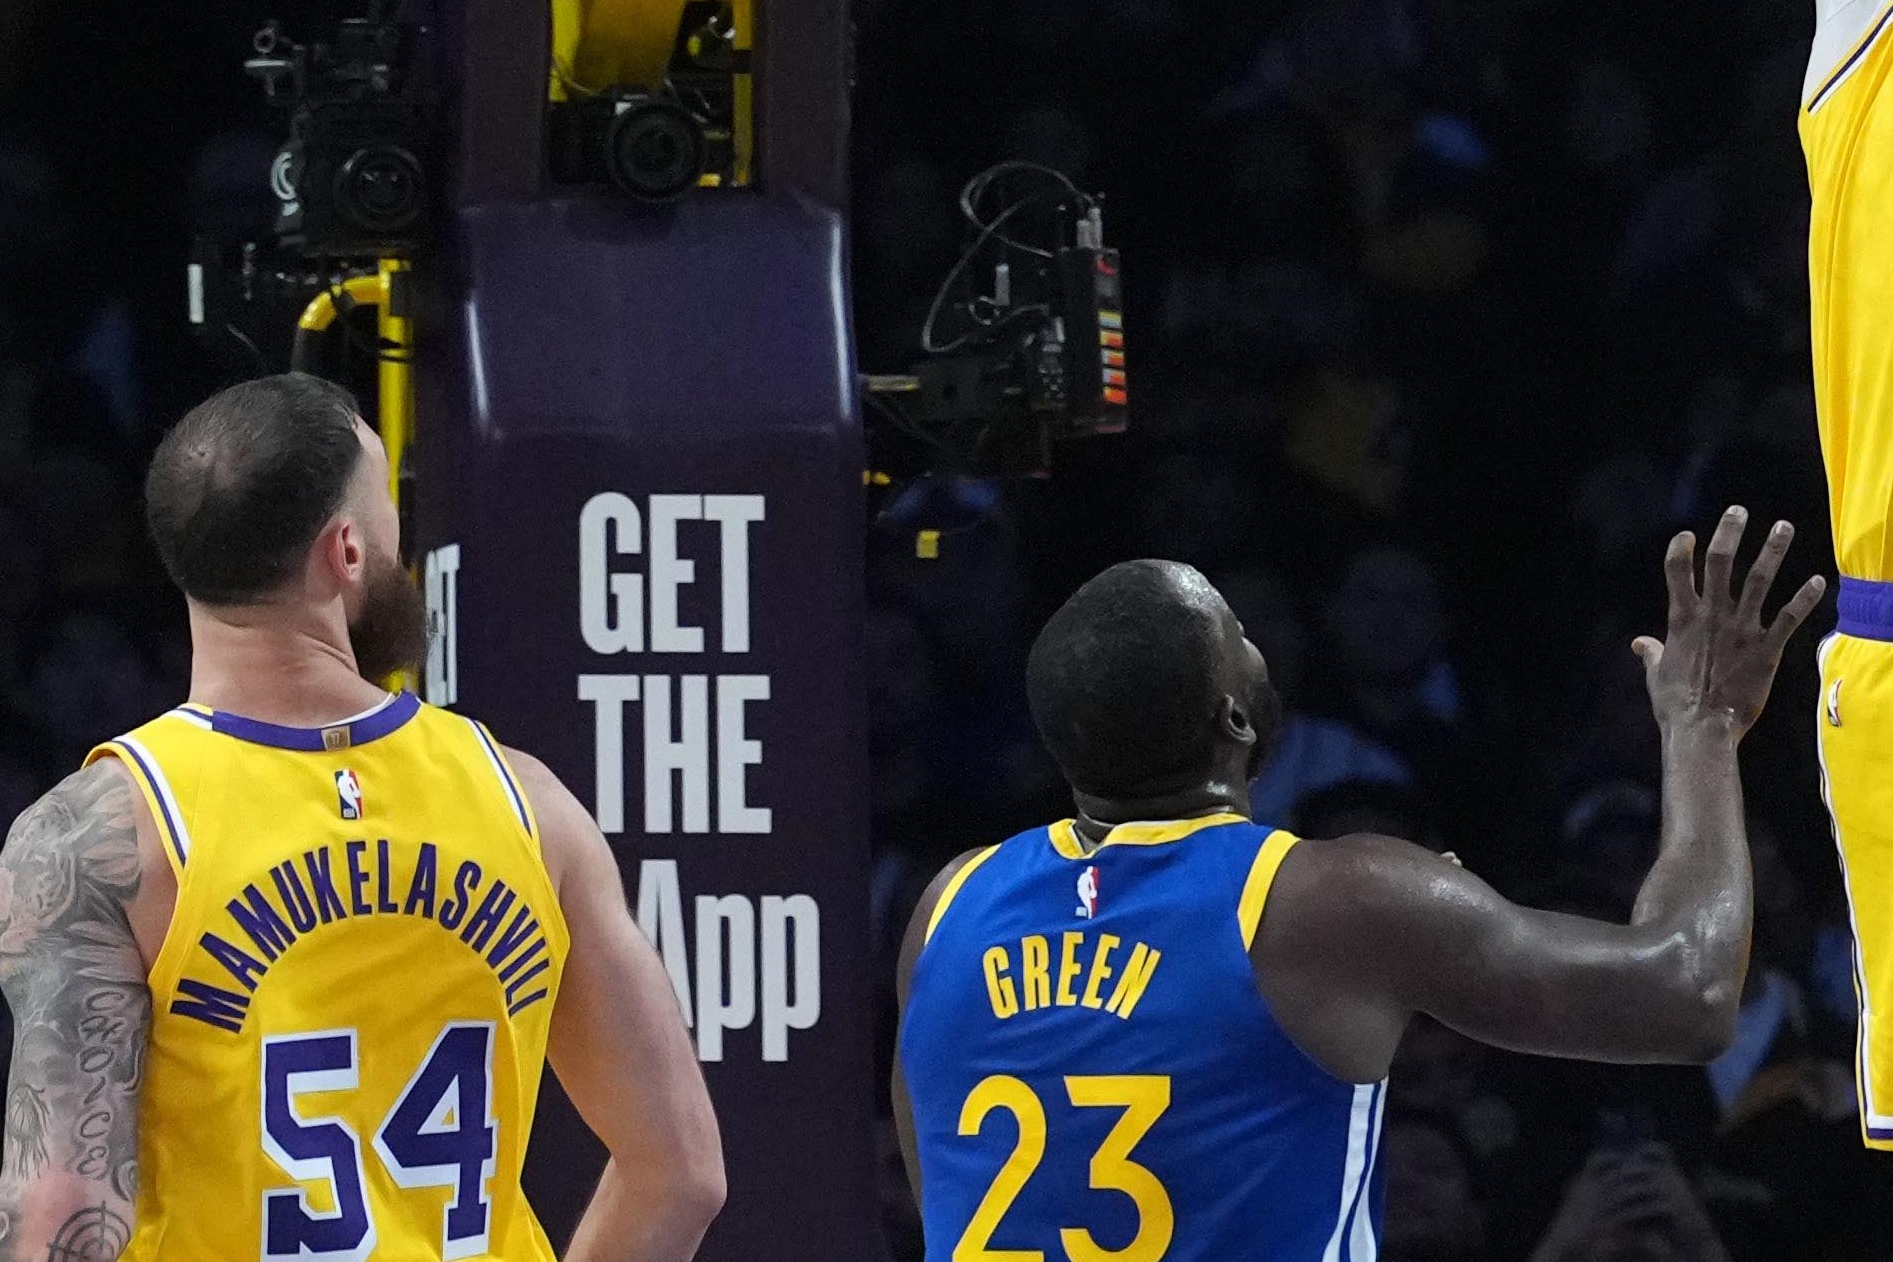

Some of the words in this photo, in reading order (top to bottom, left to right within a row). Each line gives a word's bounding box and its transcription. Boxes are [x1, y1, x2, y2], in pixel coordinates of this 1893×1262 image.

[579, 491, 765, 655] GET
[577, 674, 772, 834] THE
[170, 840, 548, 1034] MAMUKELASHVILI
[637, 859, 821, 1062] App
[982, 931, 1162, 1020] GREEN
[260, 1019, 498, 1262] 54
[952, 1074, 1174, 1262] 23
